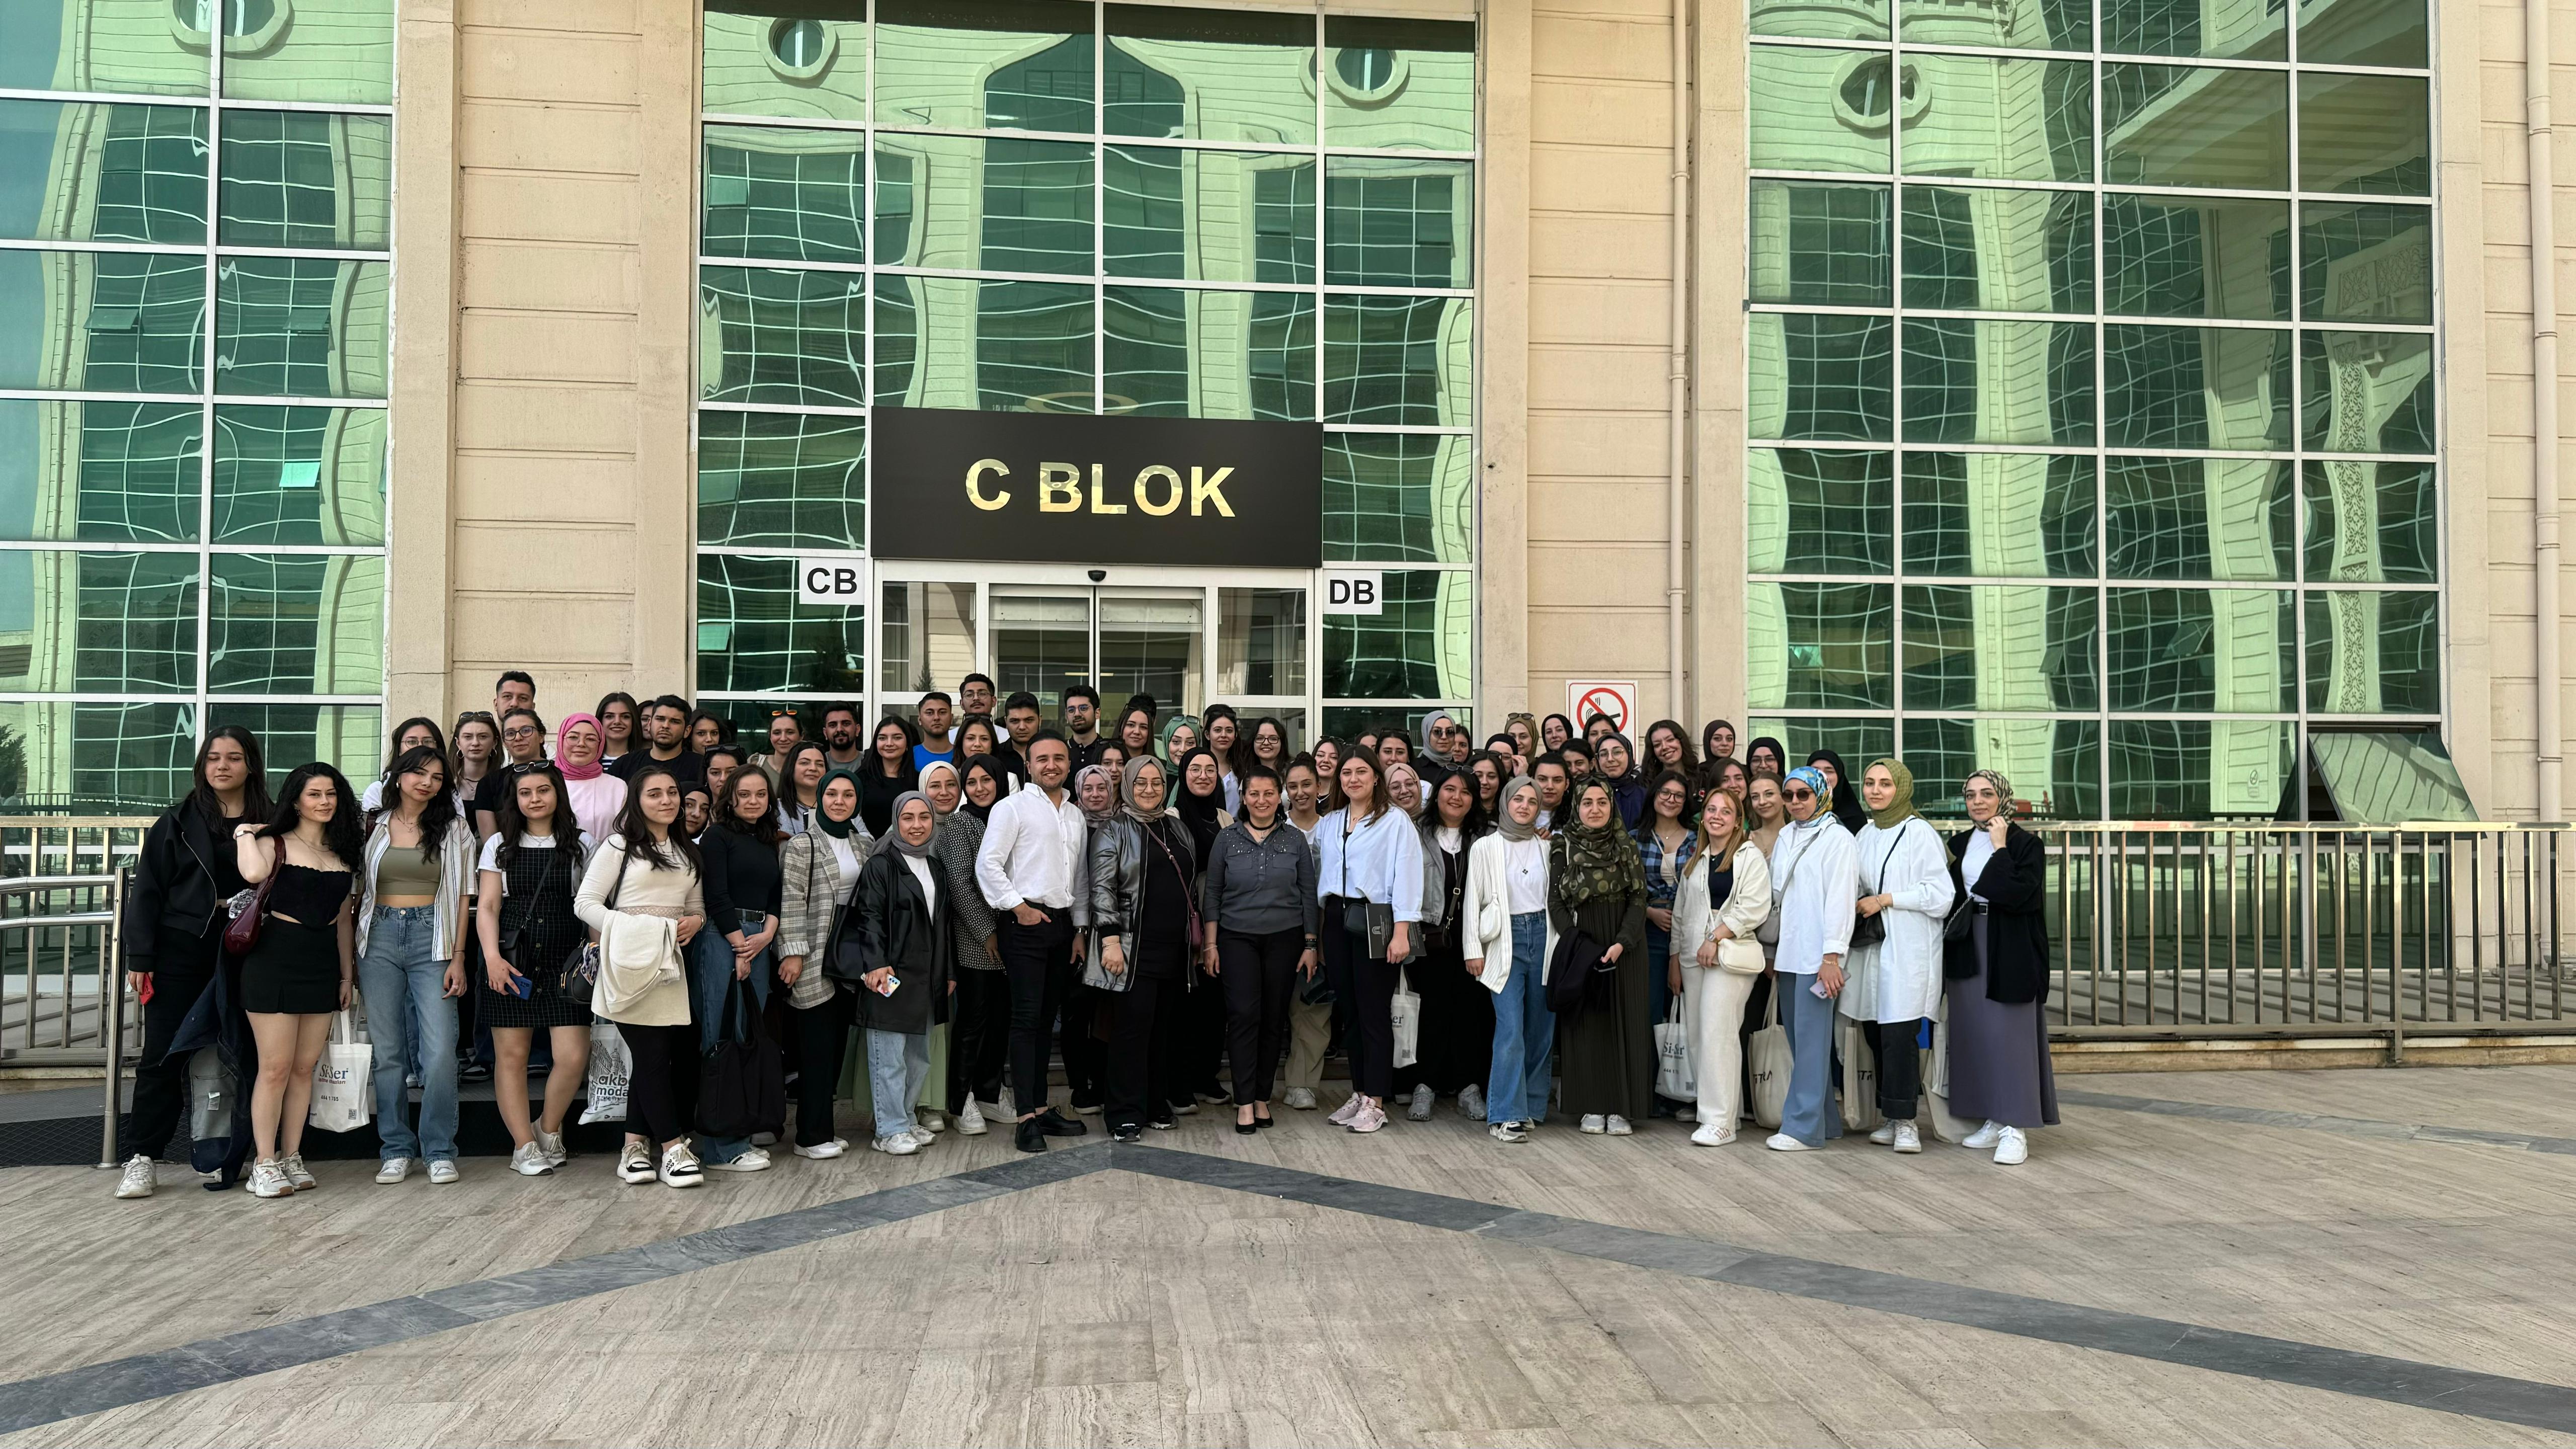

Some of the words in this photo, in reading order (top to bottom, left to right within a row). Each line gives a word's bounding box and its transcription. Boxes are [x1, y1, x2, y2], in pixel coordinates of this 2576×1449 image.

[965, 458, 1011, 511] C
[1039, 461, 1236, 517] BLOK
[806, 567, 857, 594] CB
[1330, 580, 1375, 605] DB
[1392, 1015, 1404, 1023] er
